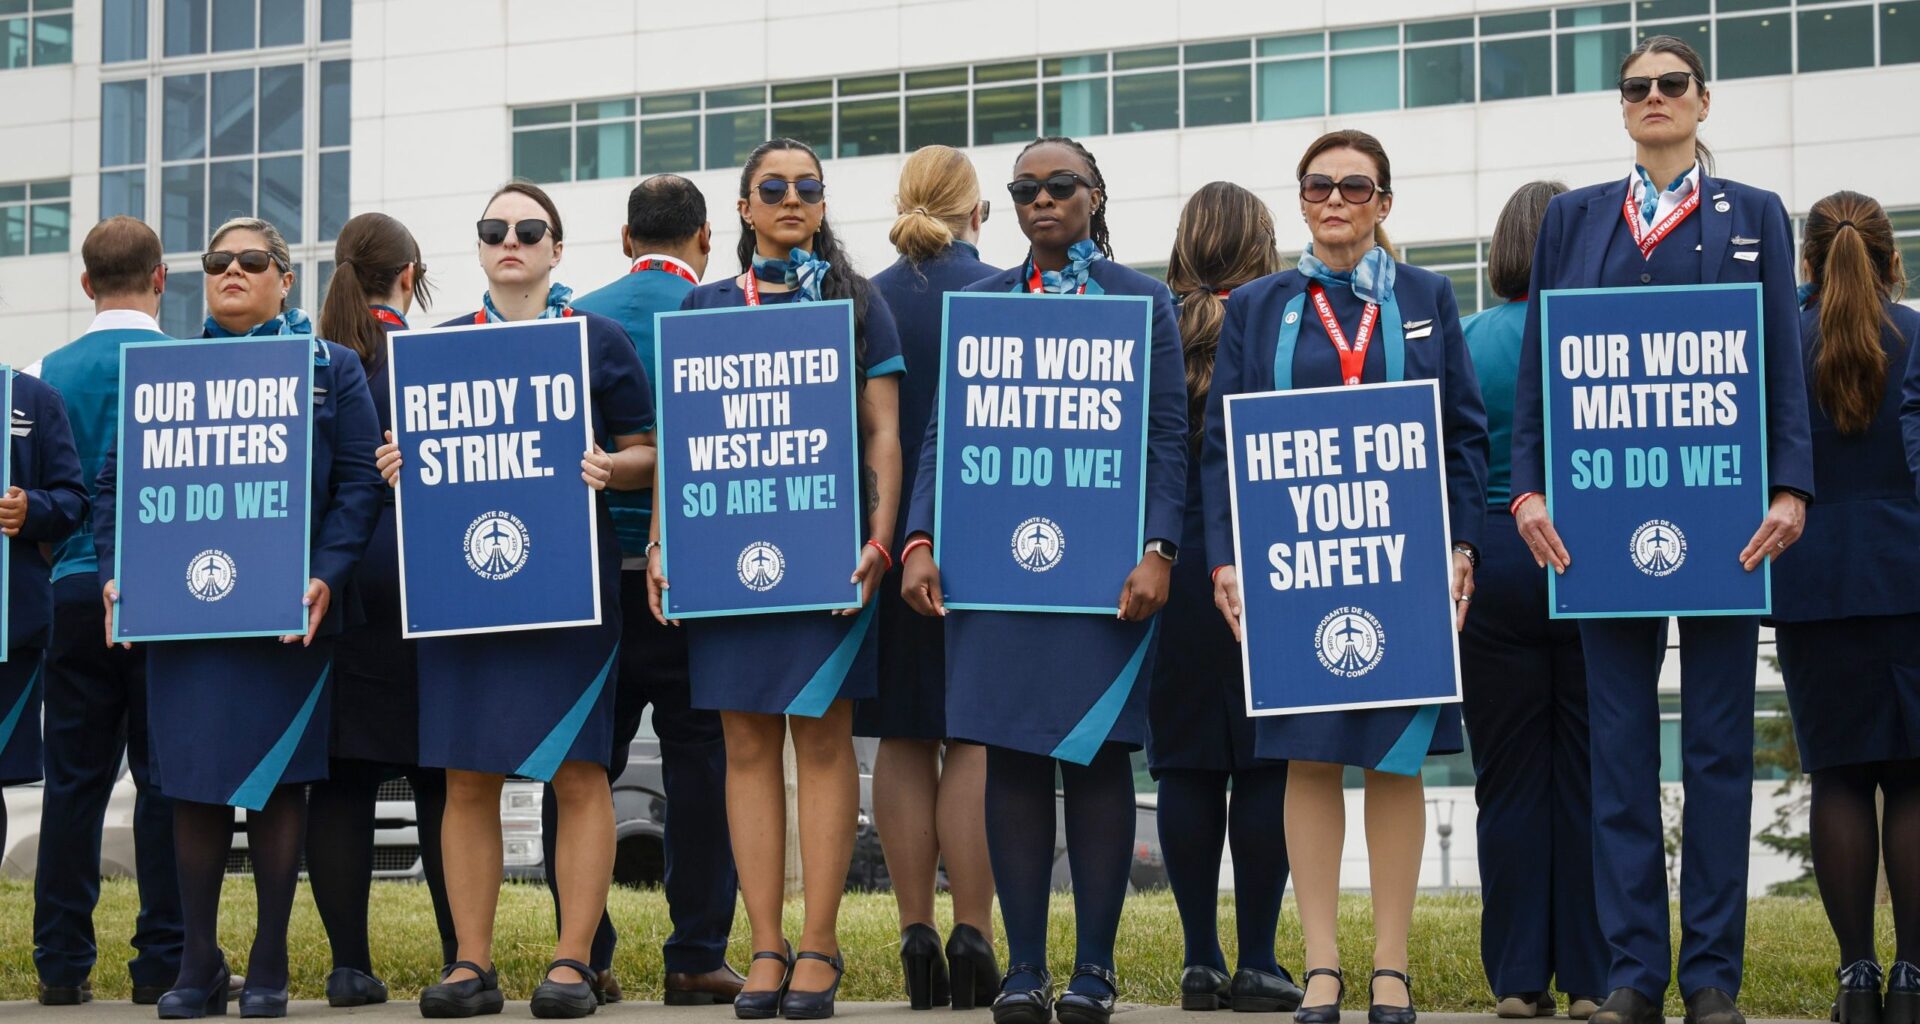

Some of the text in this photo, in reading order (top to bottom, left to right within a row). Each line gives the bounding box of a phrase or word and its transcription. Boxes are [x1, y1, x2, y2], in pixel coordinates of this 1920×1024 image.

[1655, 208, 1684, 236] CONTRAT
[1314, 292, 1349, 351] READY TO STRIKE
[1363, 314, 1373, 329] EN
[674, 348, 838, 393] FRUSTRATED
[958, 336, 1134, 381] OUR WORK
[1561, 330, 1748, 379] OUR WORK
[135, 377, 299, 423] OUR WORK
[404, 374, 575, 432] READY TO
[722, 391, 790, 429] WITH
[966, 385, 1121, 430] MATTERS
[1573, 382, 1737, 429] MATTERS
[143, 423, 287, 469] MATTERS
[419, 431, 554, 485] STRIKE.
[688, 429, 827, 471] WESTJET?
[962, 446, 1121, 488] SO DO WE!
[1246, 422, 1426, 481] HERE FOR
[1572, 445, 1741, 489] SO DO WE!
[139, 481, 288, 523] SO DO WE!
[683, 475, 836, 517] SO ARE WE!
[1288, 480, 1390, 533] YOUR
[463, 511, 530, 552] COMPOSANTE DE WESTJET
[465, 549, 529, 580] WESTJET COMPONENT
[1269, 534, 1405, 590] SAFETY
[1315, 606, 1385, 648] COMPOSANTE DE WESTJET
[1316, 646, 1384, 677] WESTJET COMPONENT
